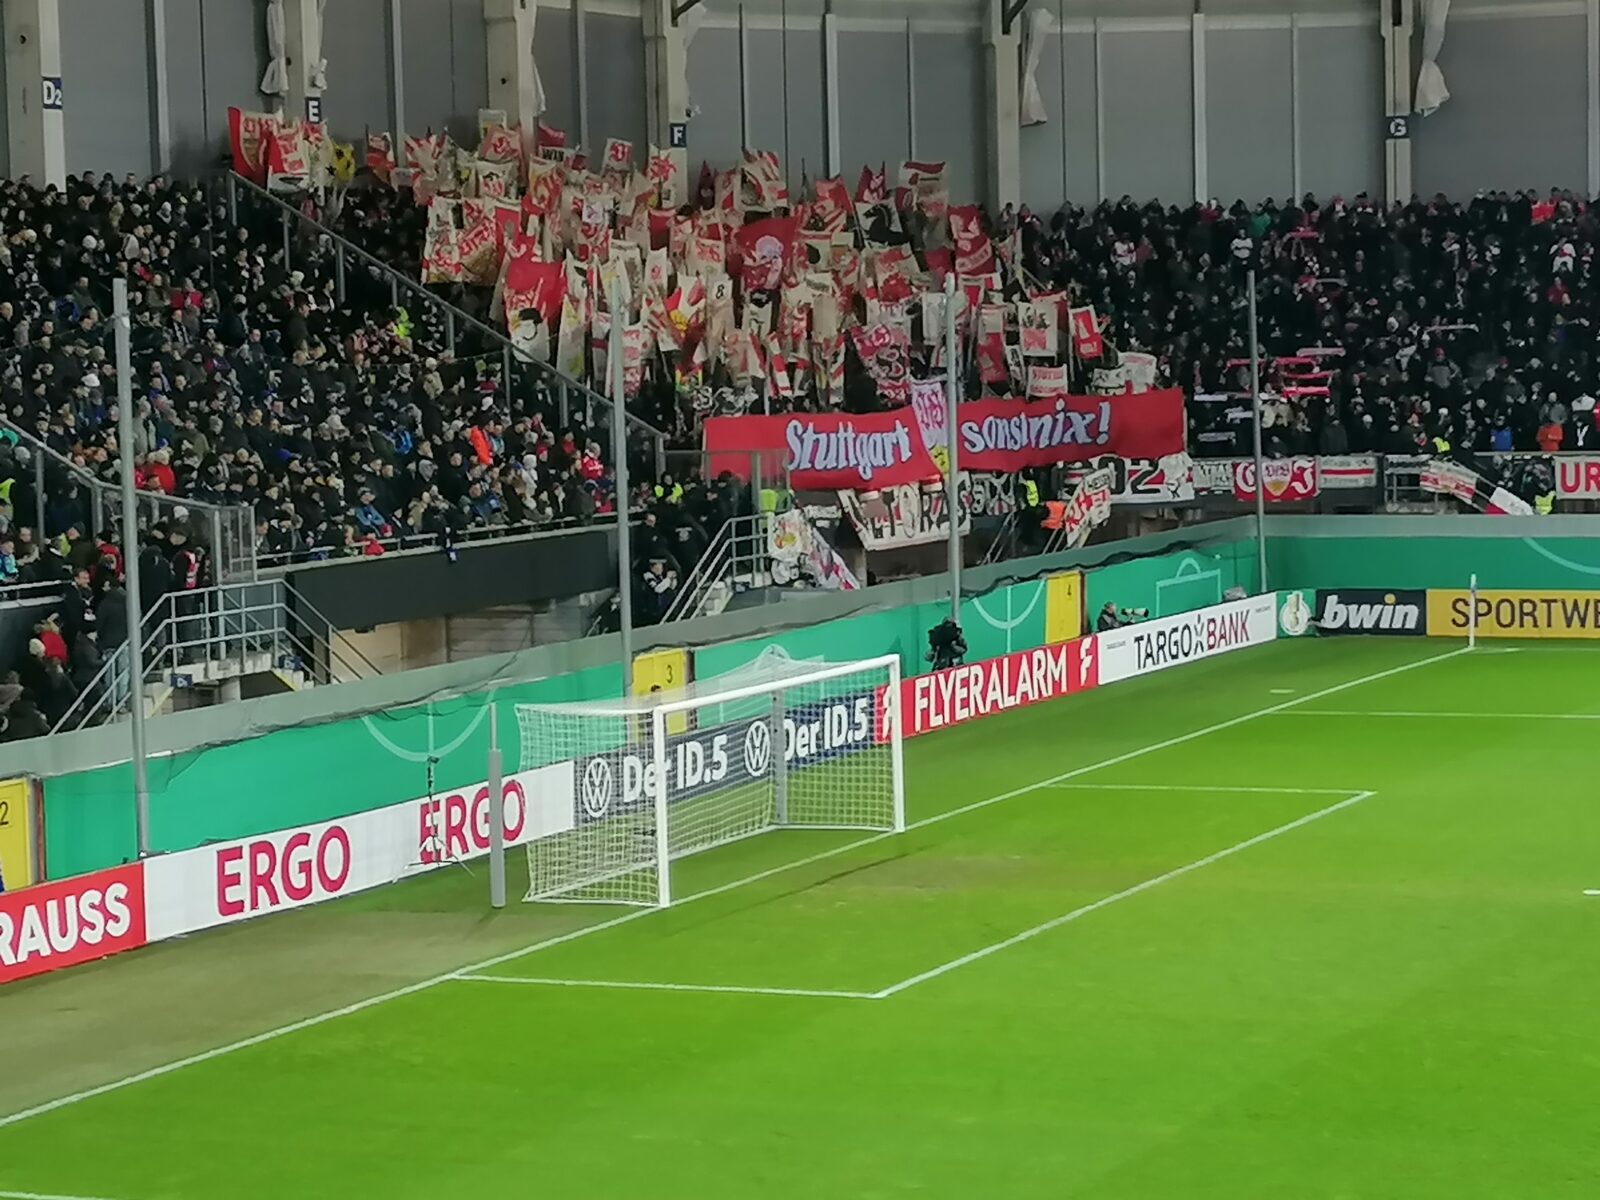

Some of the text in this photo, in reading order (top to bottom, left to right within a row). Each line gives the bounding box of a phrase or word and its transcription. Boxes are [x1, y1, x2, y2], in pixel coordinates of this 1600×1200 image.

[43, 80, 62, 106] D2
[308, 100, 319, 122] E
[673, 126, 684, 145] F
[1390, 118, 1407, 137] G
[786, 419, 912, 480] Stuttgart
[1322, 593, 1419, 629] bwin
[666, 664, 673, 684] 3
[915, 645, 1067, 732] FLYERALARM
[676, 733, 728, 791] ID.5
[420, 779, 526, 866] ERGO
[217, 825, 350, 917] ERGO
